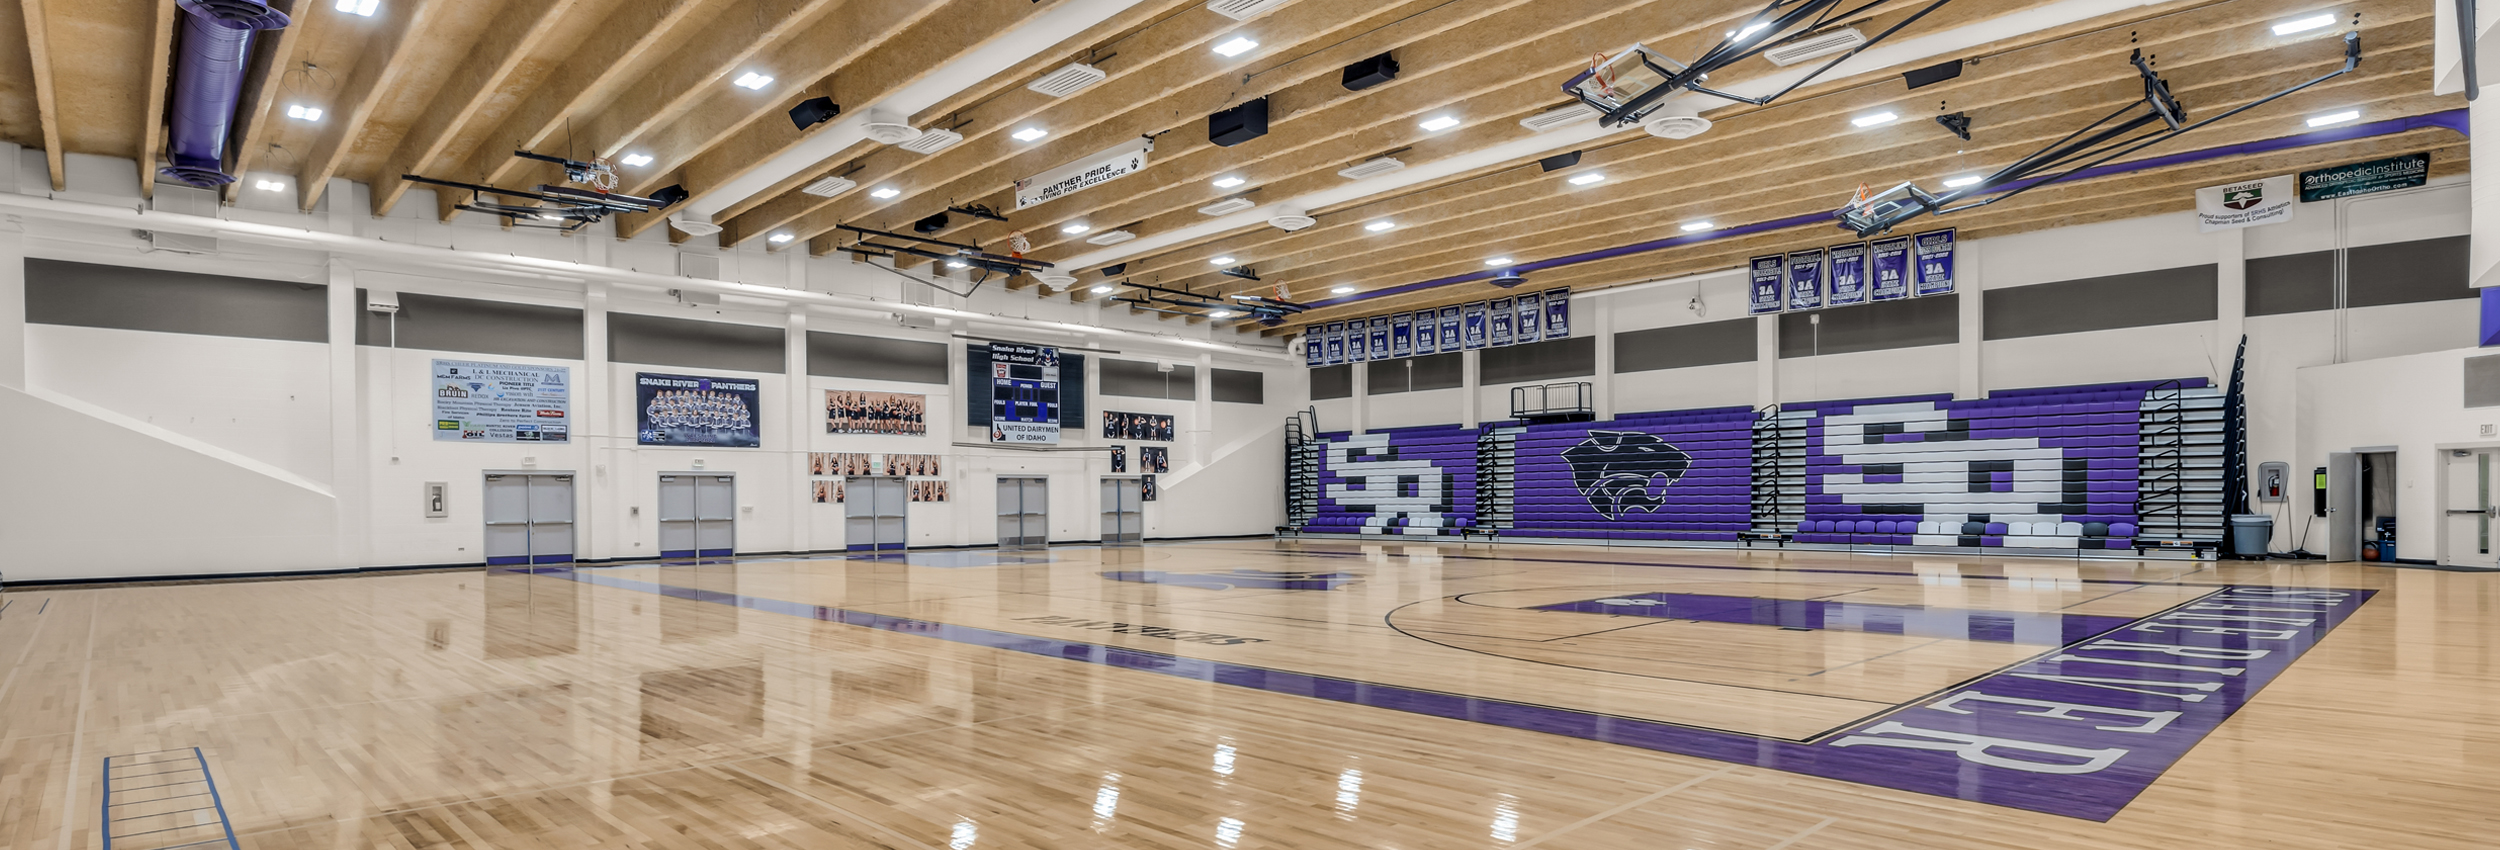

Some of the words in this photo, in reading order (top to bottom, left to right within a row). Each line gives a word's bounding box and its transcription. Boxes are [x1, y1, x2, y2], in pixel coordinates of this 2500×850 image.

[1043, 175, 1082, 194] PANTHER
[1085, 164, 1111, 179] PRIDE
[1064, 184, 1077, 194] FOR
[1080, 168, 1126, 187] EXCELLENCE
[2223, 183, 2263, 193] BETASEED
[2215, 212, 2243, 220] supporters
[2268, 201, 2290, 212] Athletics
[2252, 208, 2284, 221] Consulting!
[1922, 234, 1947, 246] GIRLS
[1873, 240, 1907, 254] WRESTLING
[1832, 247, 1863, 259] WRESTLING
[1758, 260, 1776, 269] GIRLS
[1791, 254, 1821, 264] FOOTBALL
[1926, 263, 1944, 274] 3A
[1839, 274, 1855, 285] 3A
[1882, 269, 1899, 280] 3A
[1926, 274, 1944, 282] STATE
[1759, 285, 1774, 295] 3A
[1798, 280, 1813, 290] 3A
[992, 344, 1014, 353] Snake
[1010, 354, 1034, 362] School
[640, 378, 671, 386] SNAKE
[711, 382, 756, 391] PANTHERS
[439, 390, 467, 398] BRUIN
[2480, 424, 2493, 434] EXIT
[1828, 639, 2270, 775] RIVER
